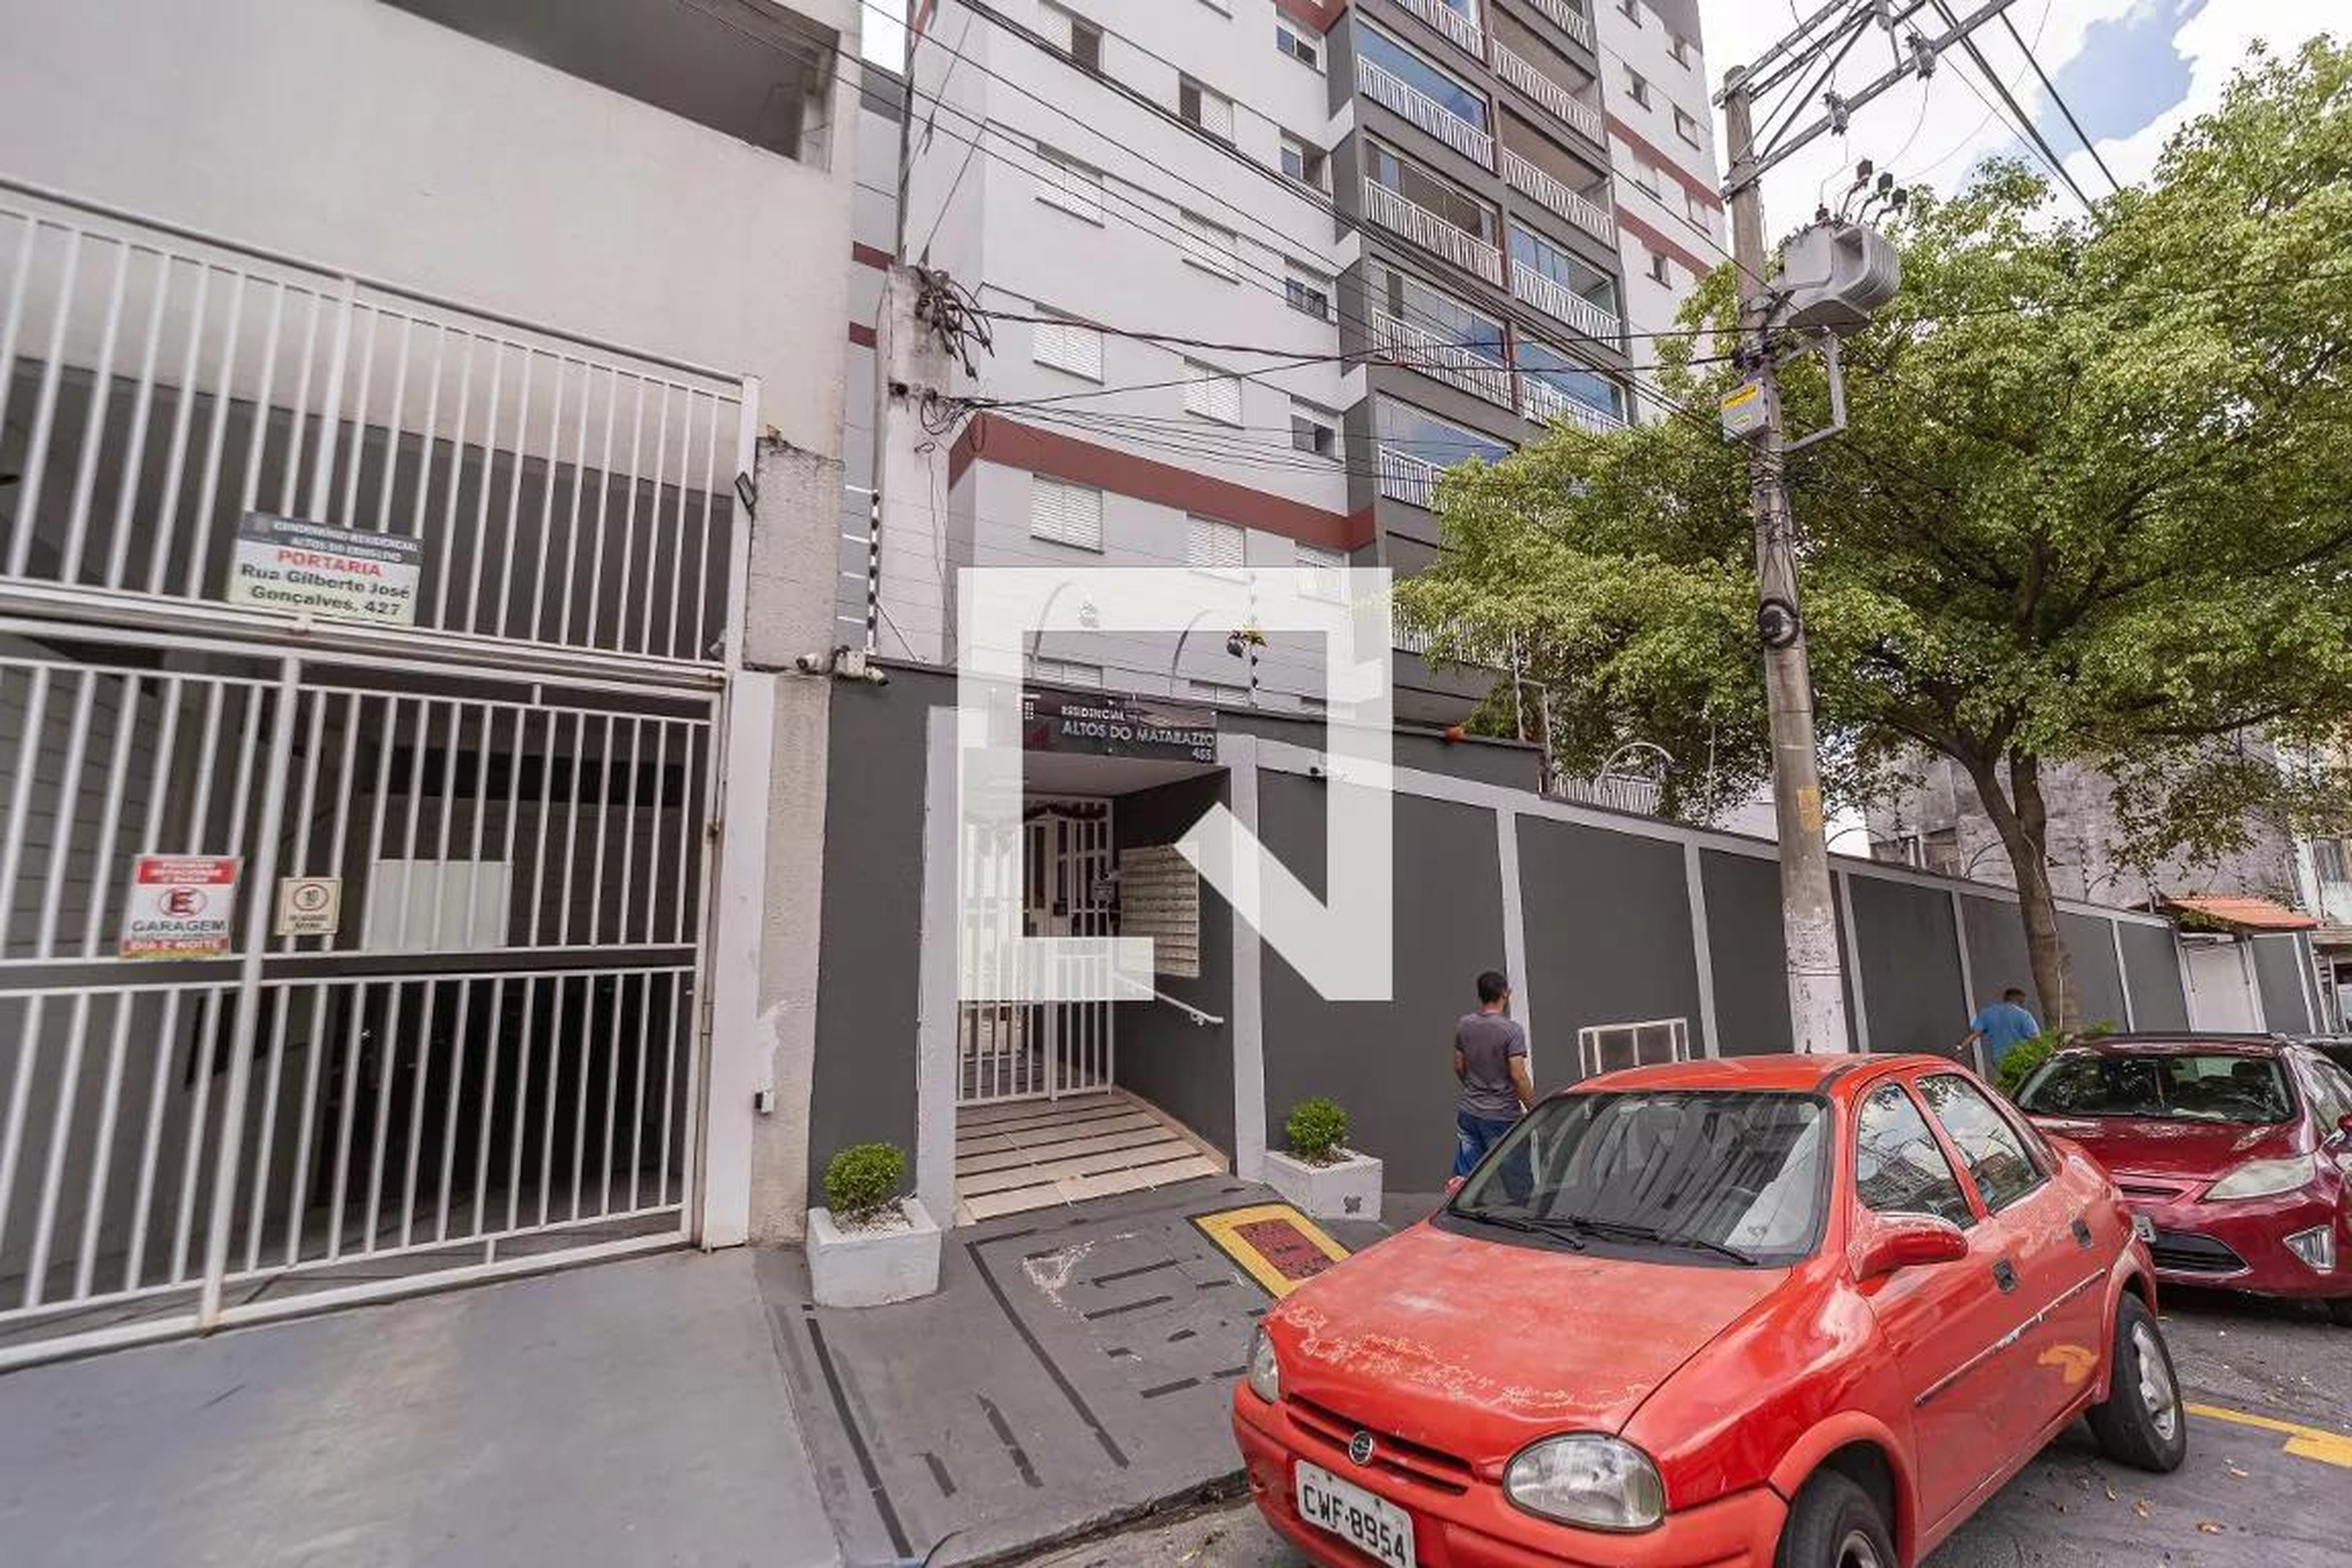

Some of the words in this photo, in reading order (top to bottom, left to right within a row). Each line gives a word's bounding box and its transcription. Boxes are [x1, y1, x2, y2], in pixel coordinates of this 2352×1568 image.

[277, 549, 382, 576] PORTARIA
[241, 564, 280, 580] Rua
[286, 570, 365, 592] Gilberto
[368, 581, 411, 599] José
[251, 584, 358, 612] Gonçalves,
[364, 601, 401, 616] 427
[1061, 720, 1106, 737] ALTOS
[1109, 725, 1132, 741] DO
[1136, 728, 1215, 747] MATARAZZO
[131, 920, 227, 932] GARAGEM
